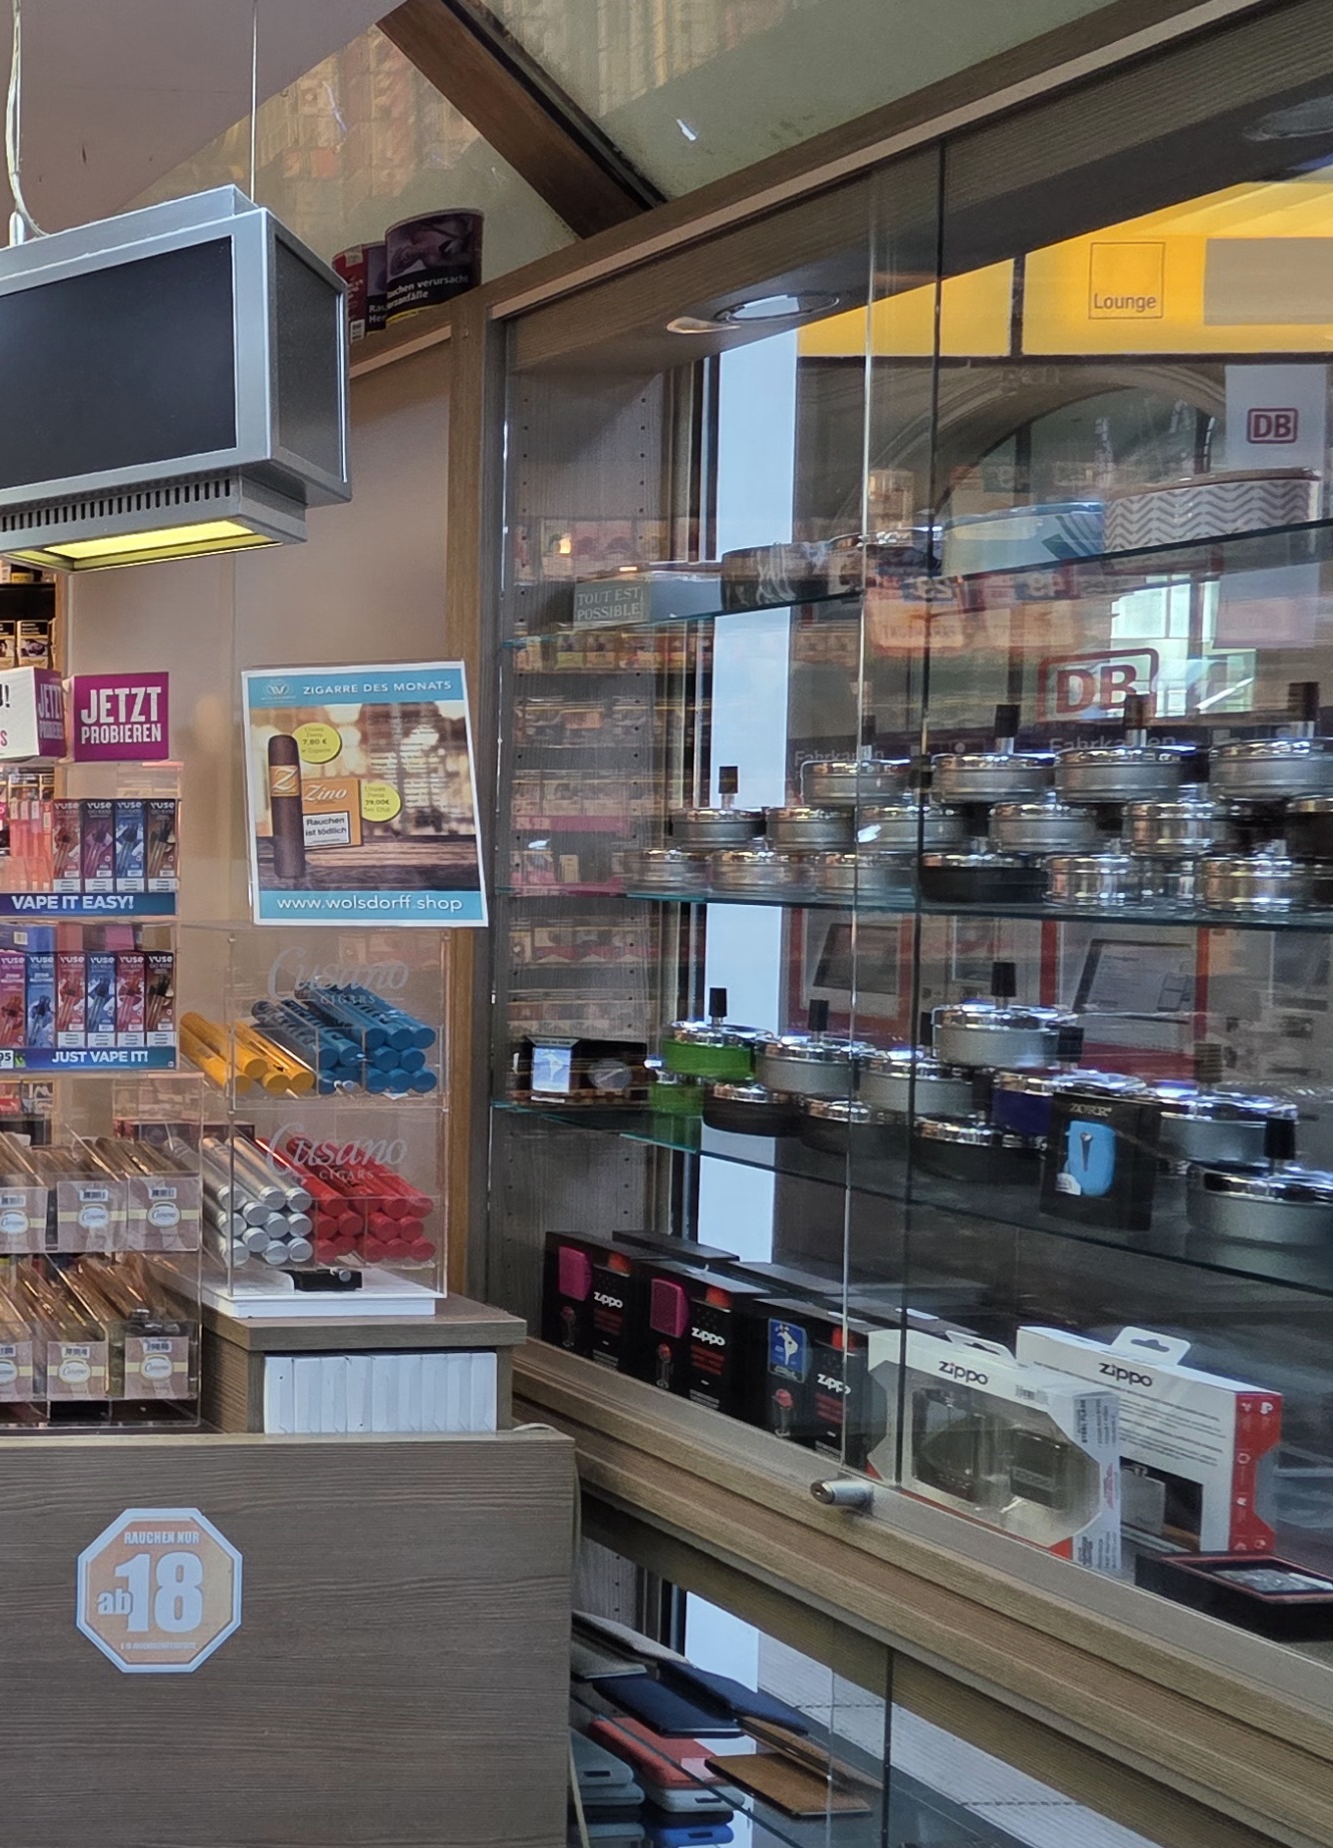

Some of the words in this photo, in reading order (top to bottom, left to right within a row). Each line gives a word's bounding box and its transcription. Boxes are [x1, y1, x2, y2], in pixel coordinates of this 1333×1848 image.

[1093, 291, 1157, 311] Lounge
[1254, 412, 1292, 439] DB
[302, 684, 359, 696] ZIGARRE
[363, 683, 389, 694] DES
[393, 680, 451, 692] MONATS
[1056, 665, 1136, 711] DB
[81, 686, 162, 724] JETZT
[81, 723, 162, 744] PROBIEREN
[305, 784, 348, 802] Zino
[305, 827, 317, 836] ist
[318, 826, 348, 836] tödlich
[306, 817, 345, 827] Rauchen
[11, 895, 60, 909] VAPE
[62, 896, 80, 909] IT
[82, 896, 134, 909] EASY!
[277, 895, 463, 913] www.wolsdorff.shop
[52, 1051, 86, 1063] JUST
[89, 1051, 129, 1063] VAPE
[131, 1051, 148, 1063] IT!
[265, 1122, 408, 1176] Cusano
[319, 1171, 375, 1180] CIGARS
[594, 1292, 623, 1309] zippo
[691, 1327, 726, 1346] zippo
[938, 1360, 988, 1385] zippo
[1099, 1362, 1153, 1387] zippo
[124, 1531, 174, 1544] RAUCHEN
[177, 1531, 200, 1543] NUR
[97, 1588, 133, 1615] ab
[114, 1551, 204, 1633] 18
